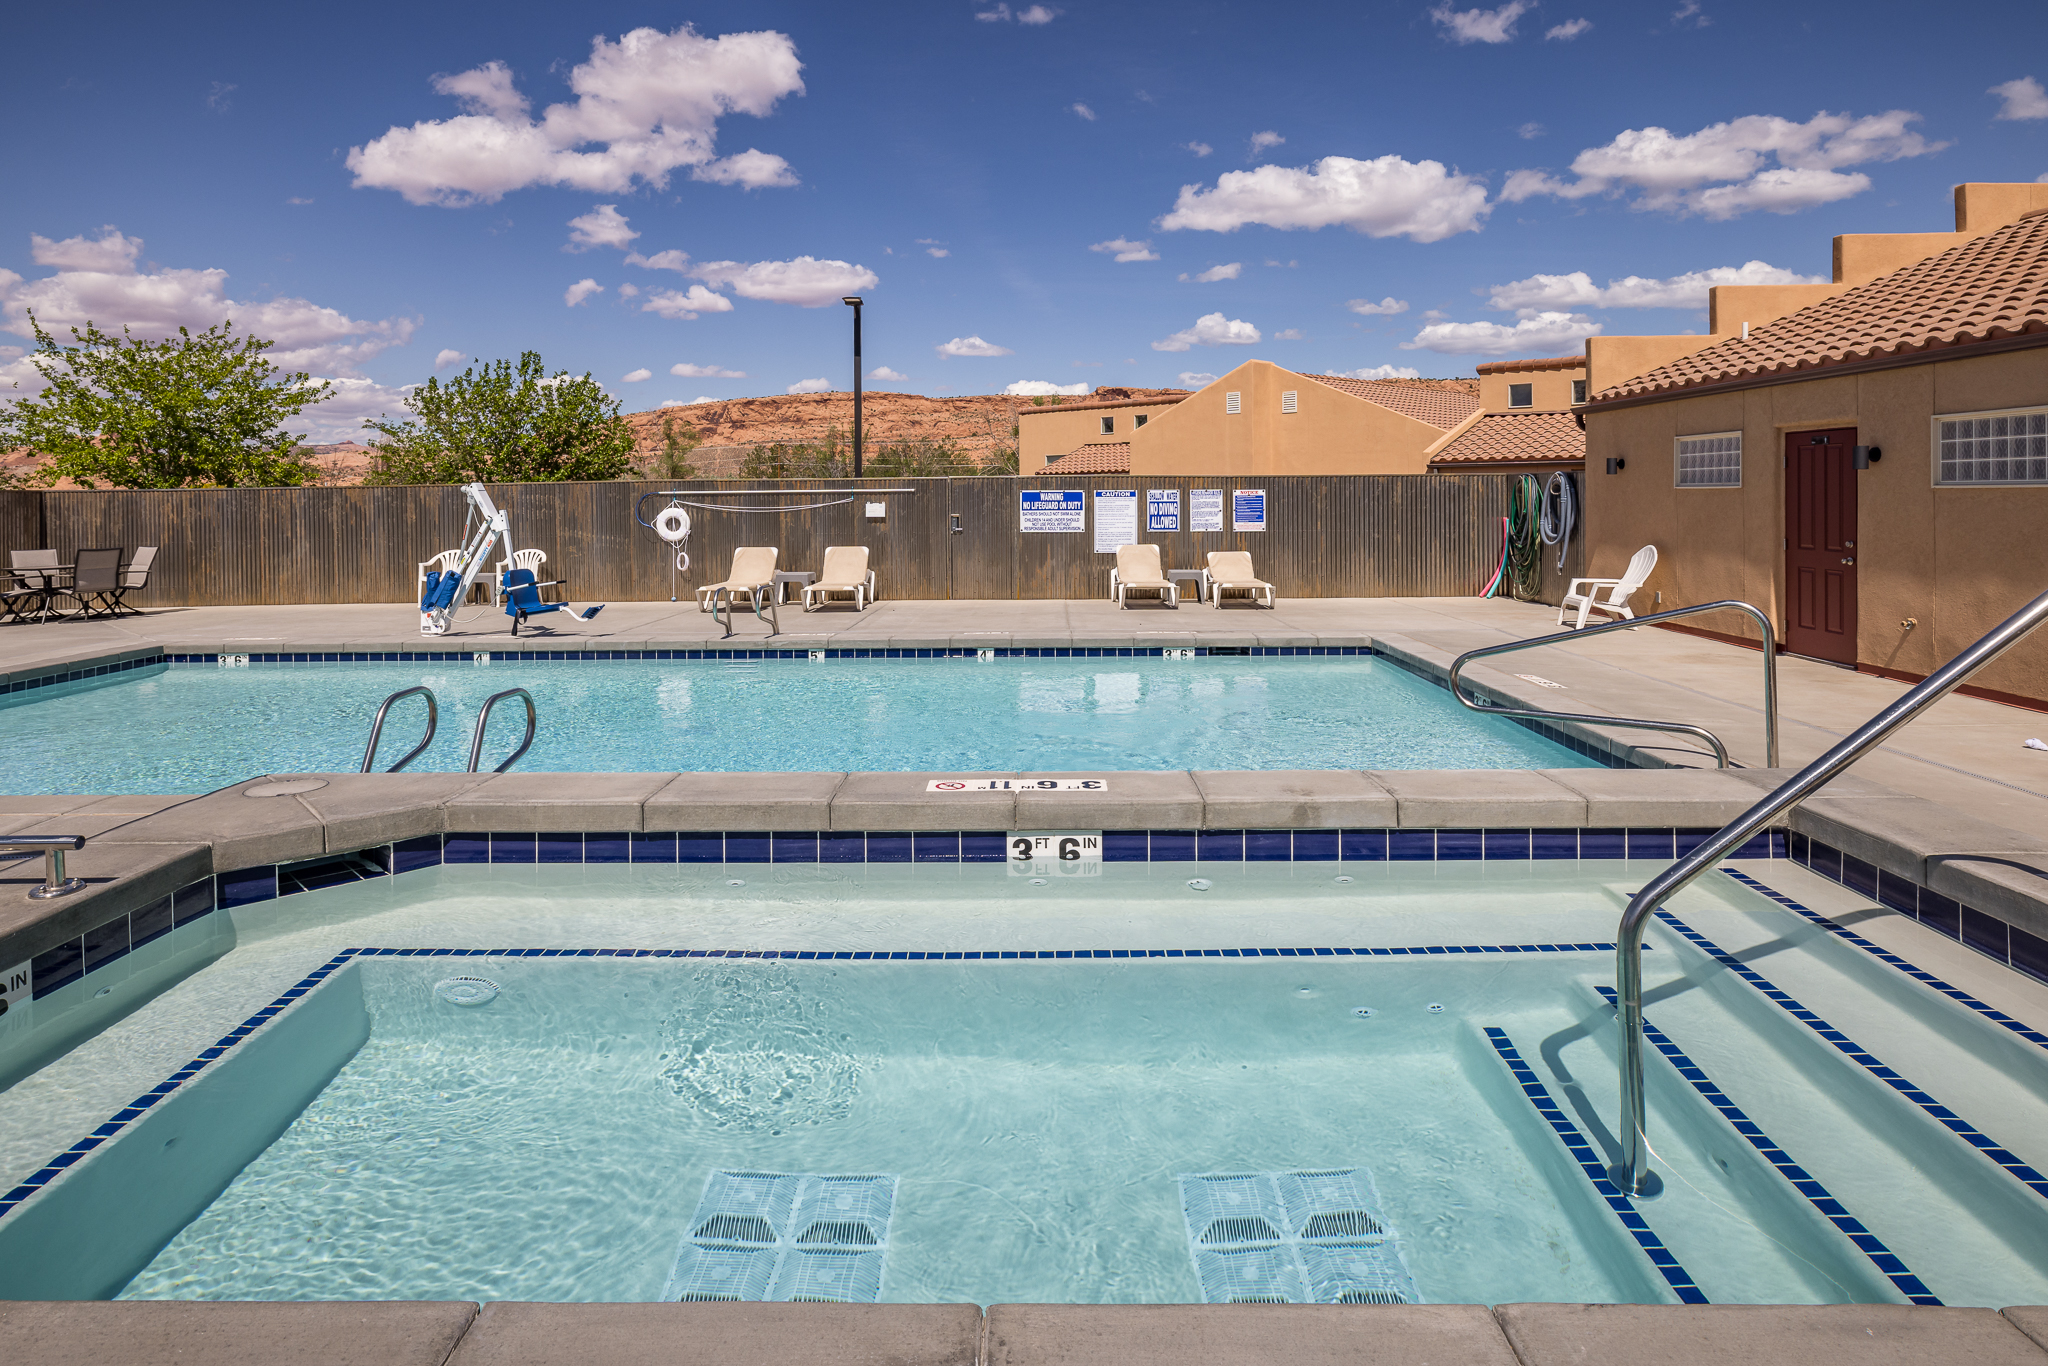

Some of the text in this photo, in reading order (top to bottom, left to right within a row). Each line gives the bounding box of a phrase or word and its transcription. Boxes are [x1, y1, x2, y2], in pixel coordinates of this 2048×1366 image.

[1040, 493, 1064, 501] WARNING
[1150, 503, 1178, 515] NO DIVING
[1151, 516, 1176, 528] ALLOWED
[1037, 780, 1058, 789] 6
[1081, 780, 1101, 789] 3
[1012, 837, 1097, 860] 3 FT 6 IN
[10, 970, 27, 992] IN
